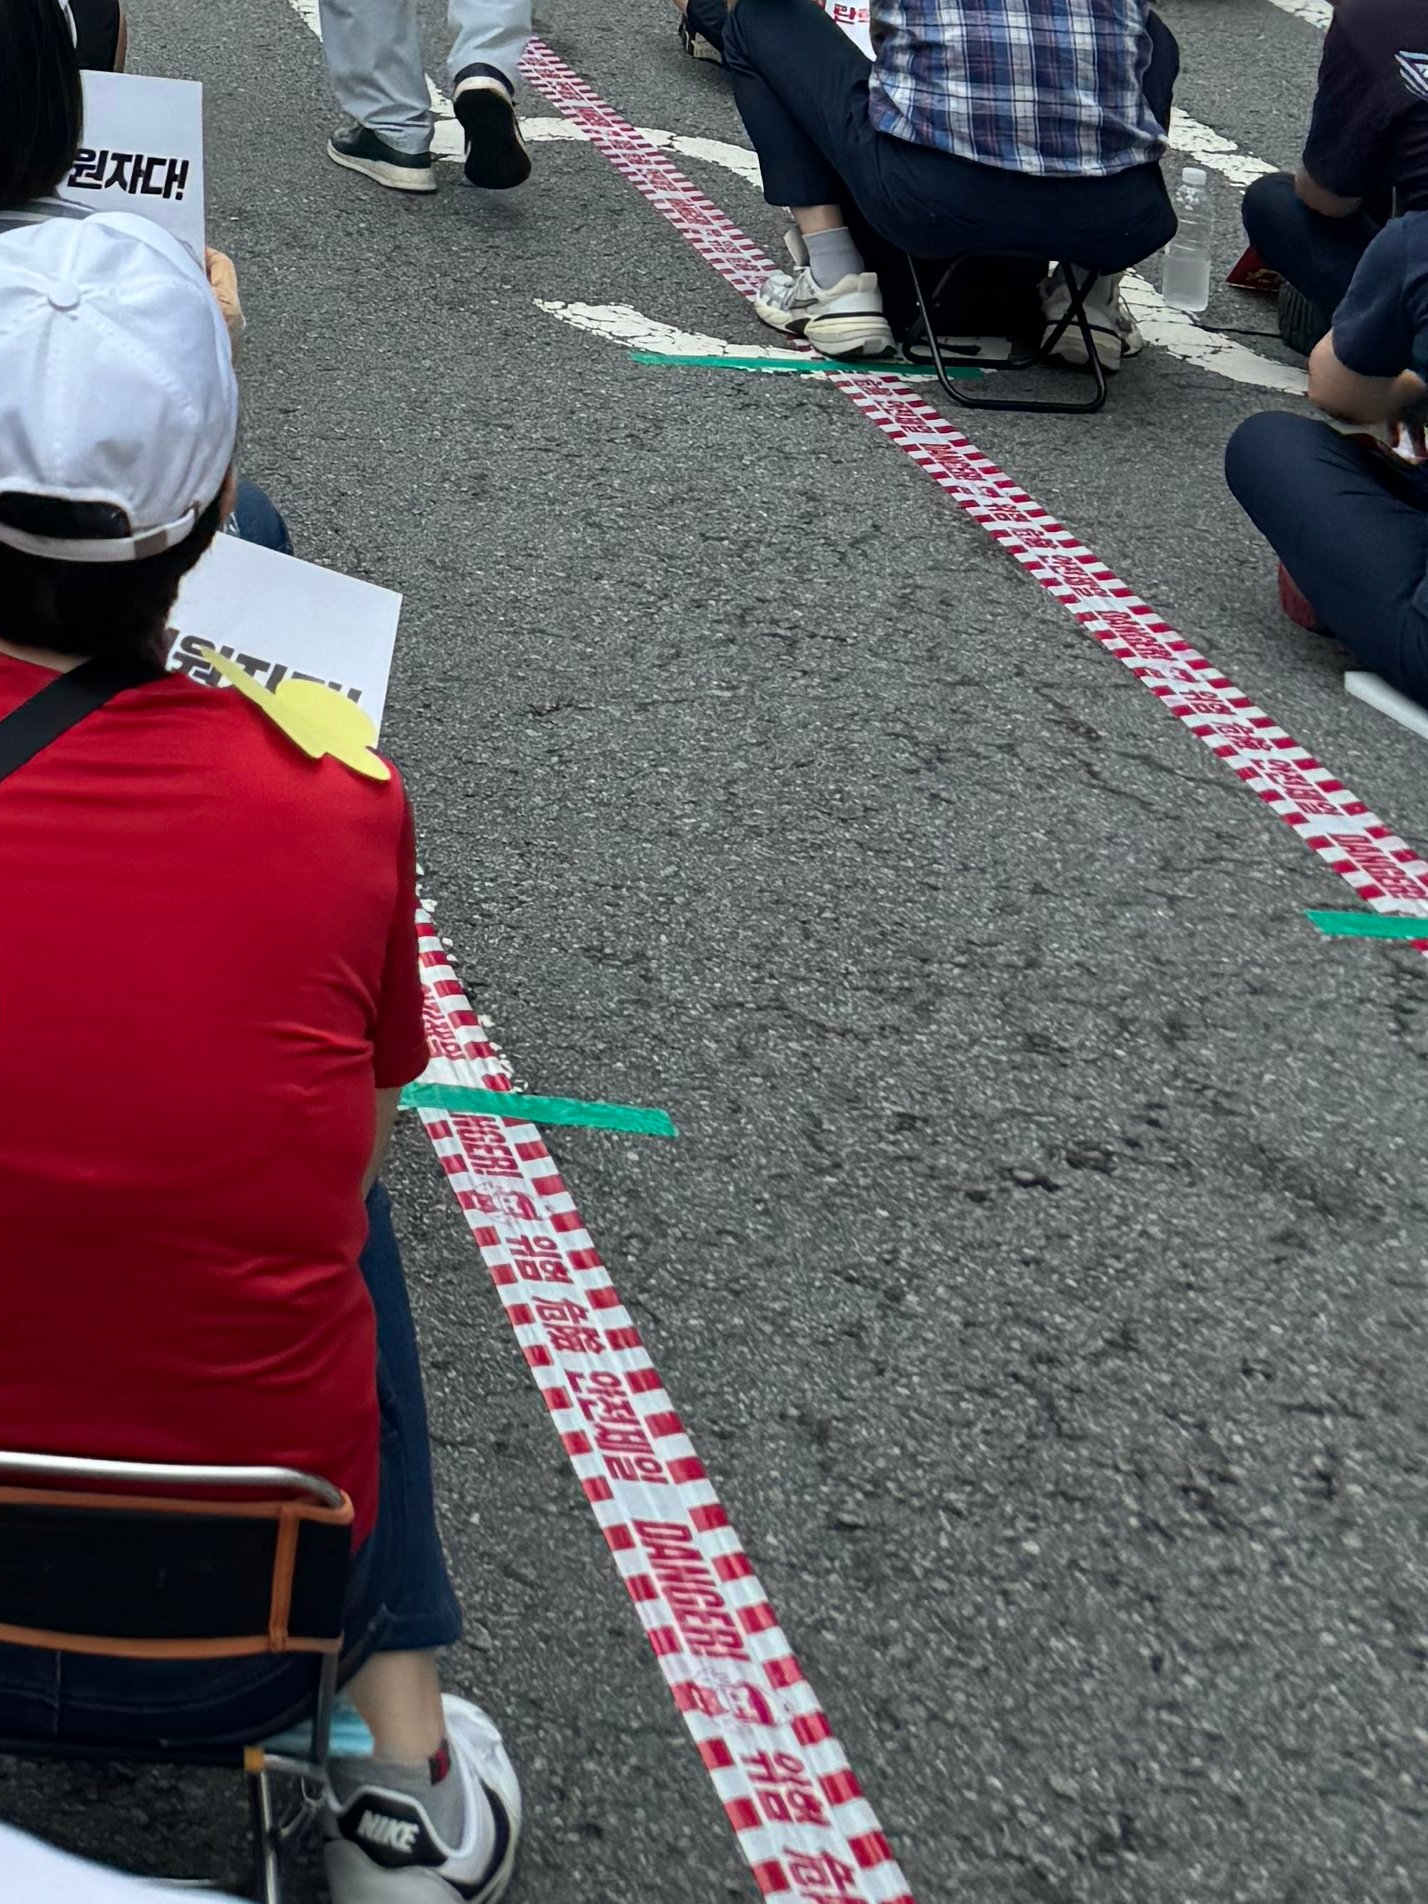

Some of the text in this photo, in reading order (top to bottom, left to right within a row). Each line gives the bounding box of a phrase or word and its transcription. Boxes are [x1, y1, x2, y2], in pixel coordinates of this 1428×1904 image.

[67, 147, 190, 201] 원자다!
[1247, 758, 1345, 816] 안전제일
[504, 1235, 575, 1285] 위험
[533, 1295, 605, 1355] 危險
[563, 1369, 670, 1487] 안전제일
[630, 1518, 752, 1664] DANGER!
[739, 1748, 833, 1828] 위험
[355, 1807, 421, 1854] NIKE
